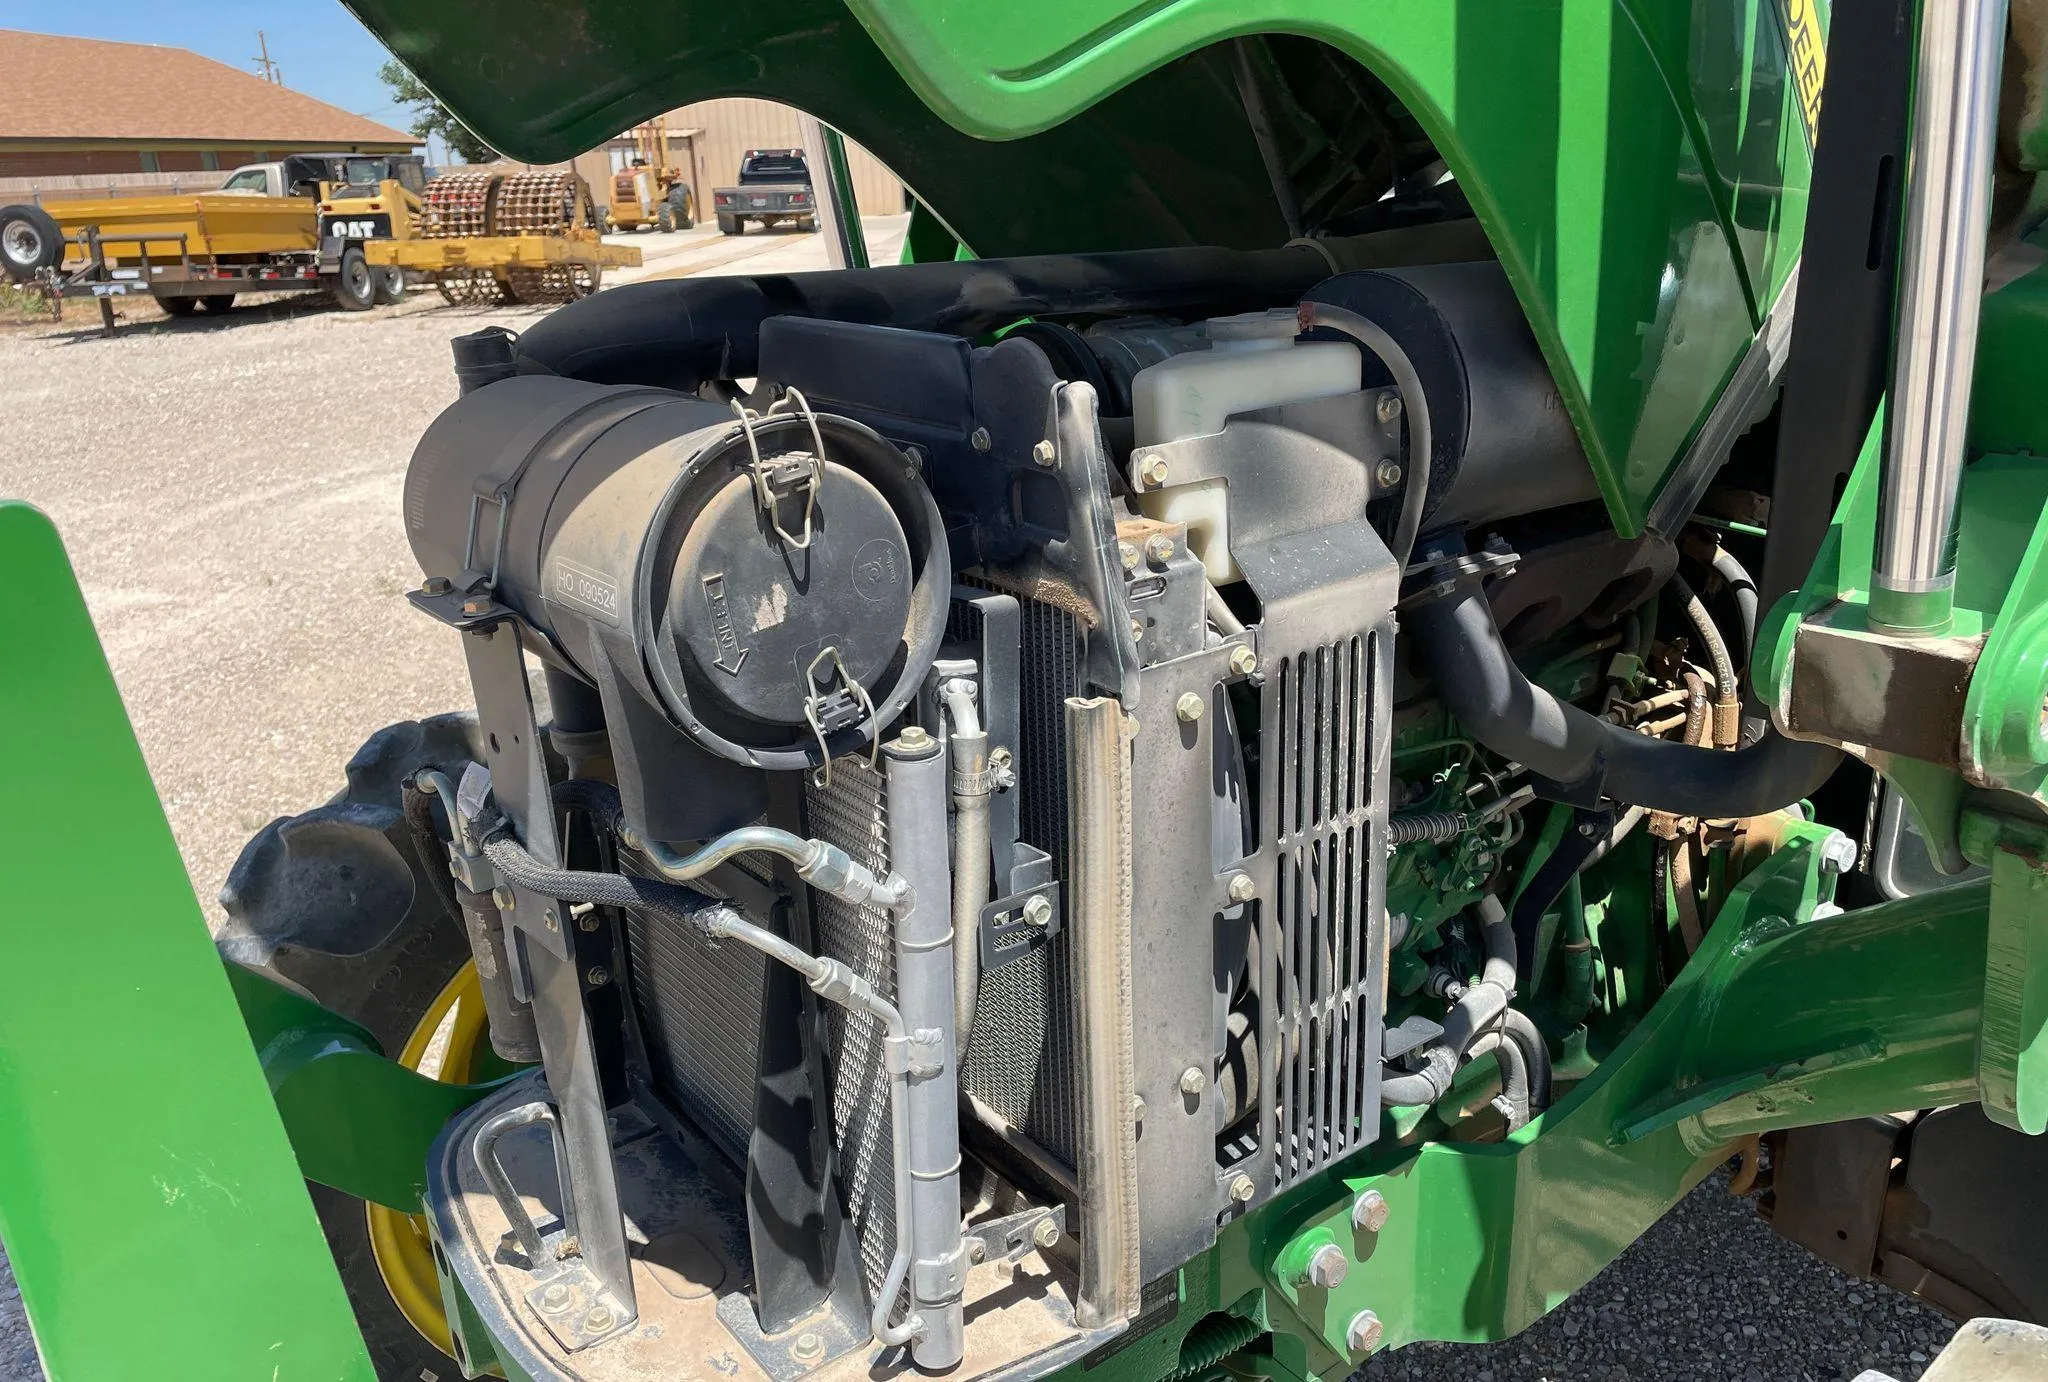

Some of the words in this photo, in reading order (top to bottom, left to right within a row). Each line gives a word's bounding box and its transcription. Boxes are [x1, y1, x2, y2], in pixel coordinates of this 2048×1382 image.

[332, 221, 375, 238] CAT
[579, 578, 616, 611] 090524
[1709, 640, 1721, 656] PSI
[1716, 657, 1728, 678] 3250
